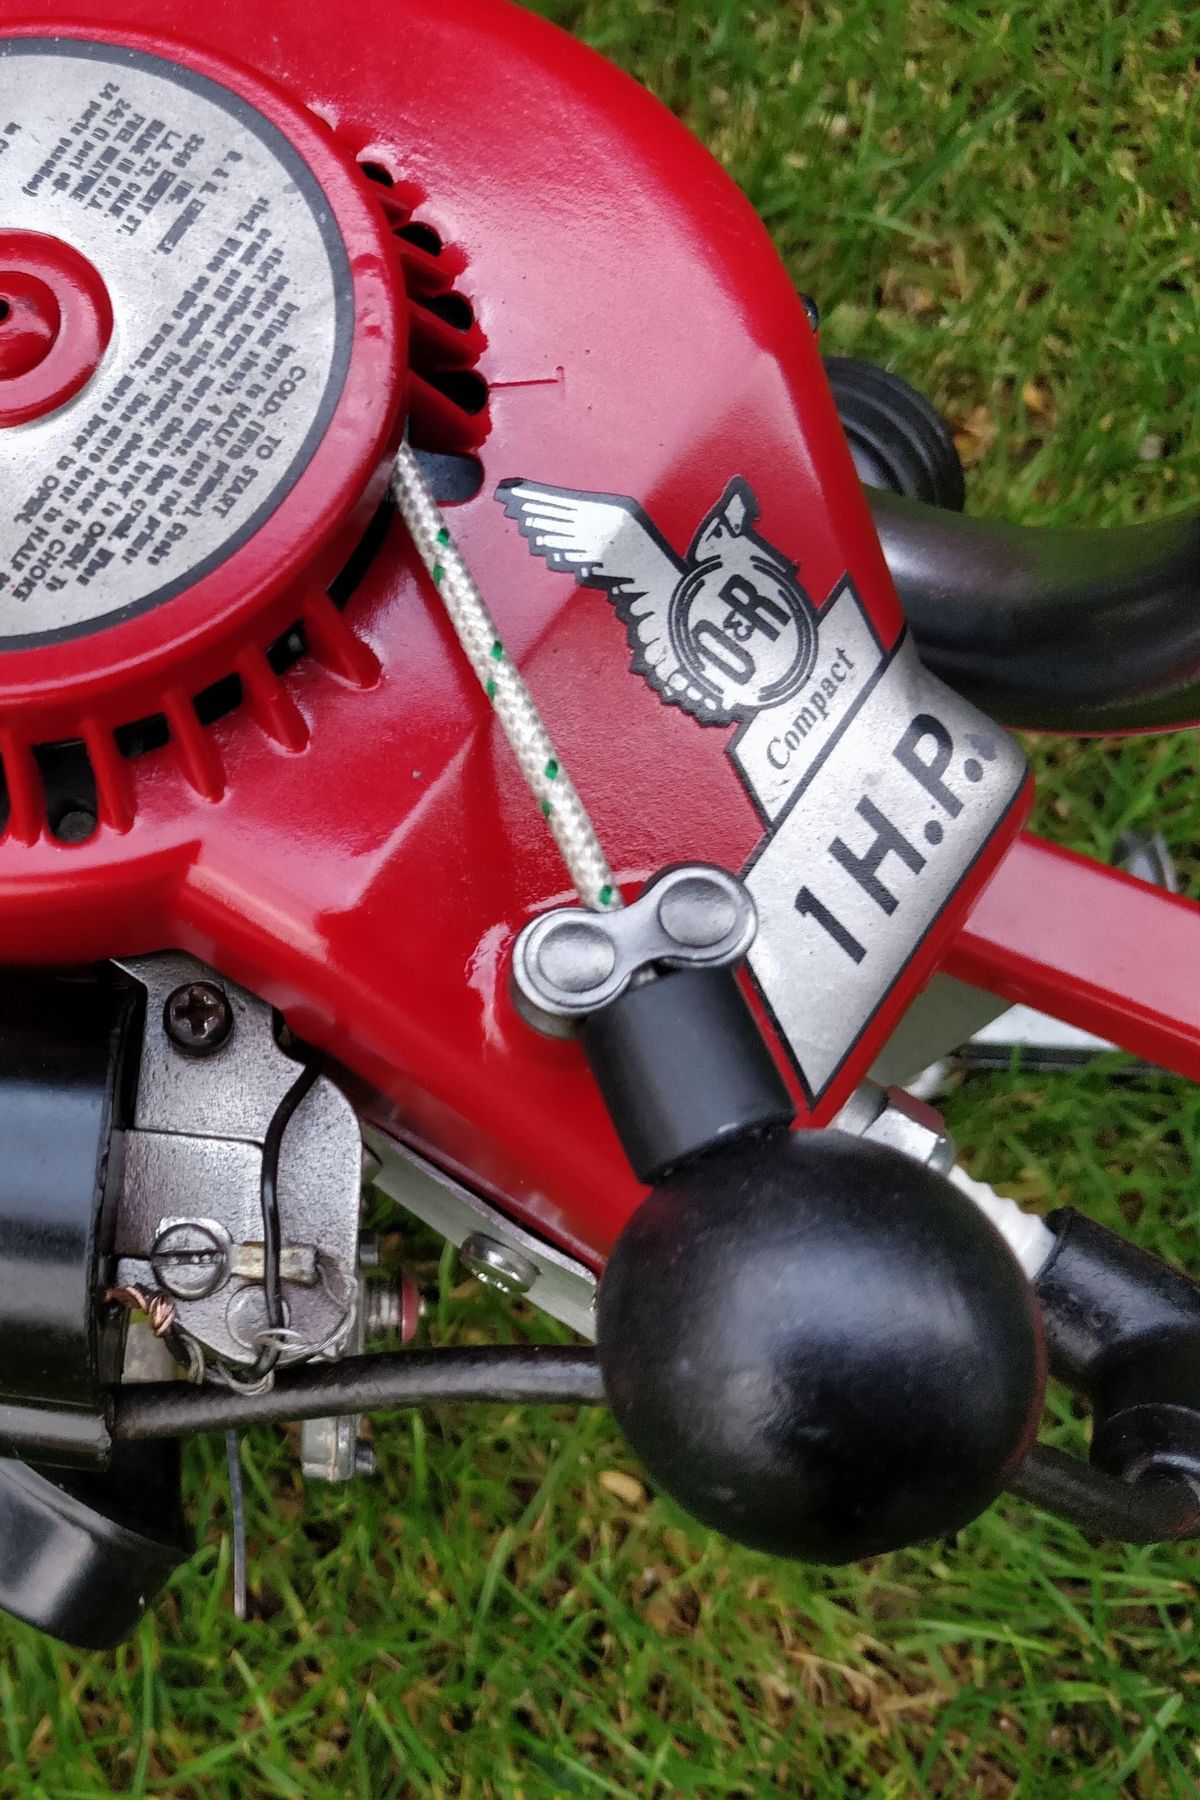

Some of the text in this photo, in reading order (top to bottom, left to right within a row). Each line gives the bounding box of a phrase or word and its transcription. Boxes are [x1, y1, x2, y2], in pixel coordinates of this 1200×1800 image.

[20, 80, 120, 198] 24 parts gasoline)
[64, 138, 96, 172] part
[66, 110, 146, 204] FUEL MIXTURE
[82, 116, 166, 214] MADE IN U.S.A.
[115, 212, 142, 238] ST.
[236, 226, 274, 268] crank
[211, 267, 244, 303] until
[174, 301, 218, 350] engine
[255, 300, 300, 350] button
[12, 194, 272, 527] start. When engine warms, move lever to OPEN.
[143, 348, 182, 389] fires,
[10, 246, 286, 604] start without using primer, choke lever to CHOKE
[117, 389, 152, 426] then
[43, 272, 292, 594] engine warms, move choke lever to OPEN. To
[86, 422, 124, 465] move
[119, 341, 296, 566] lever to HALF, push red primer
[57, 464, 95, 506] lever
[142, 462, 178, 498] then
[210, 432, 282, 520] TO START
[41, 504, 64, 526] to
[8, 523, 50, 573] HALF
[74, 544, 116, 588] When
[144, 520, 188, 568] Choke
[691, 572, 795, 688] O&R
[765, 646, 856, 772] Compact
[793, 713, 985, 966] 1 H.P.
